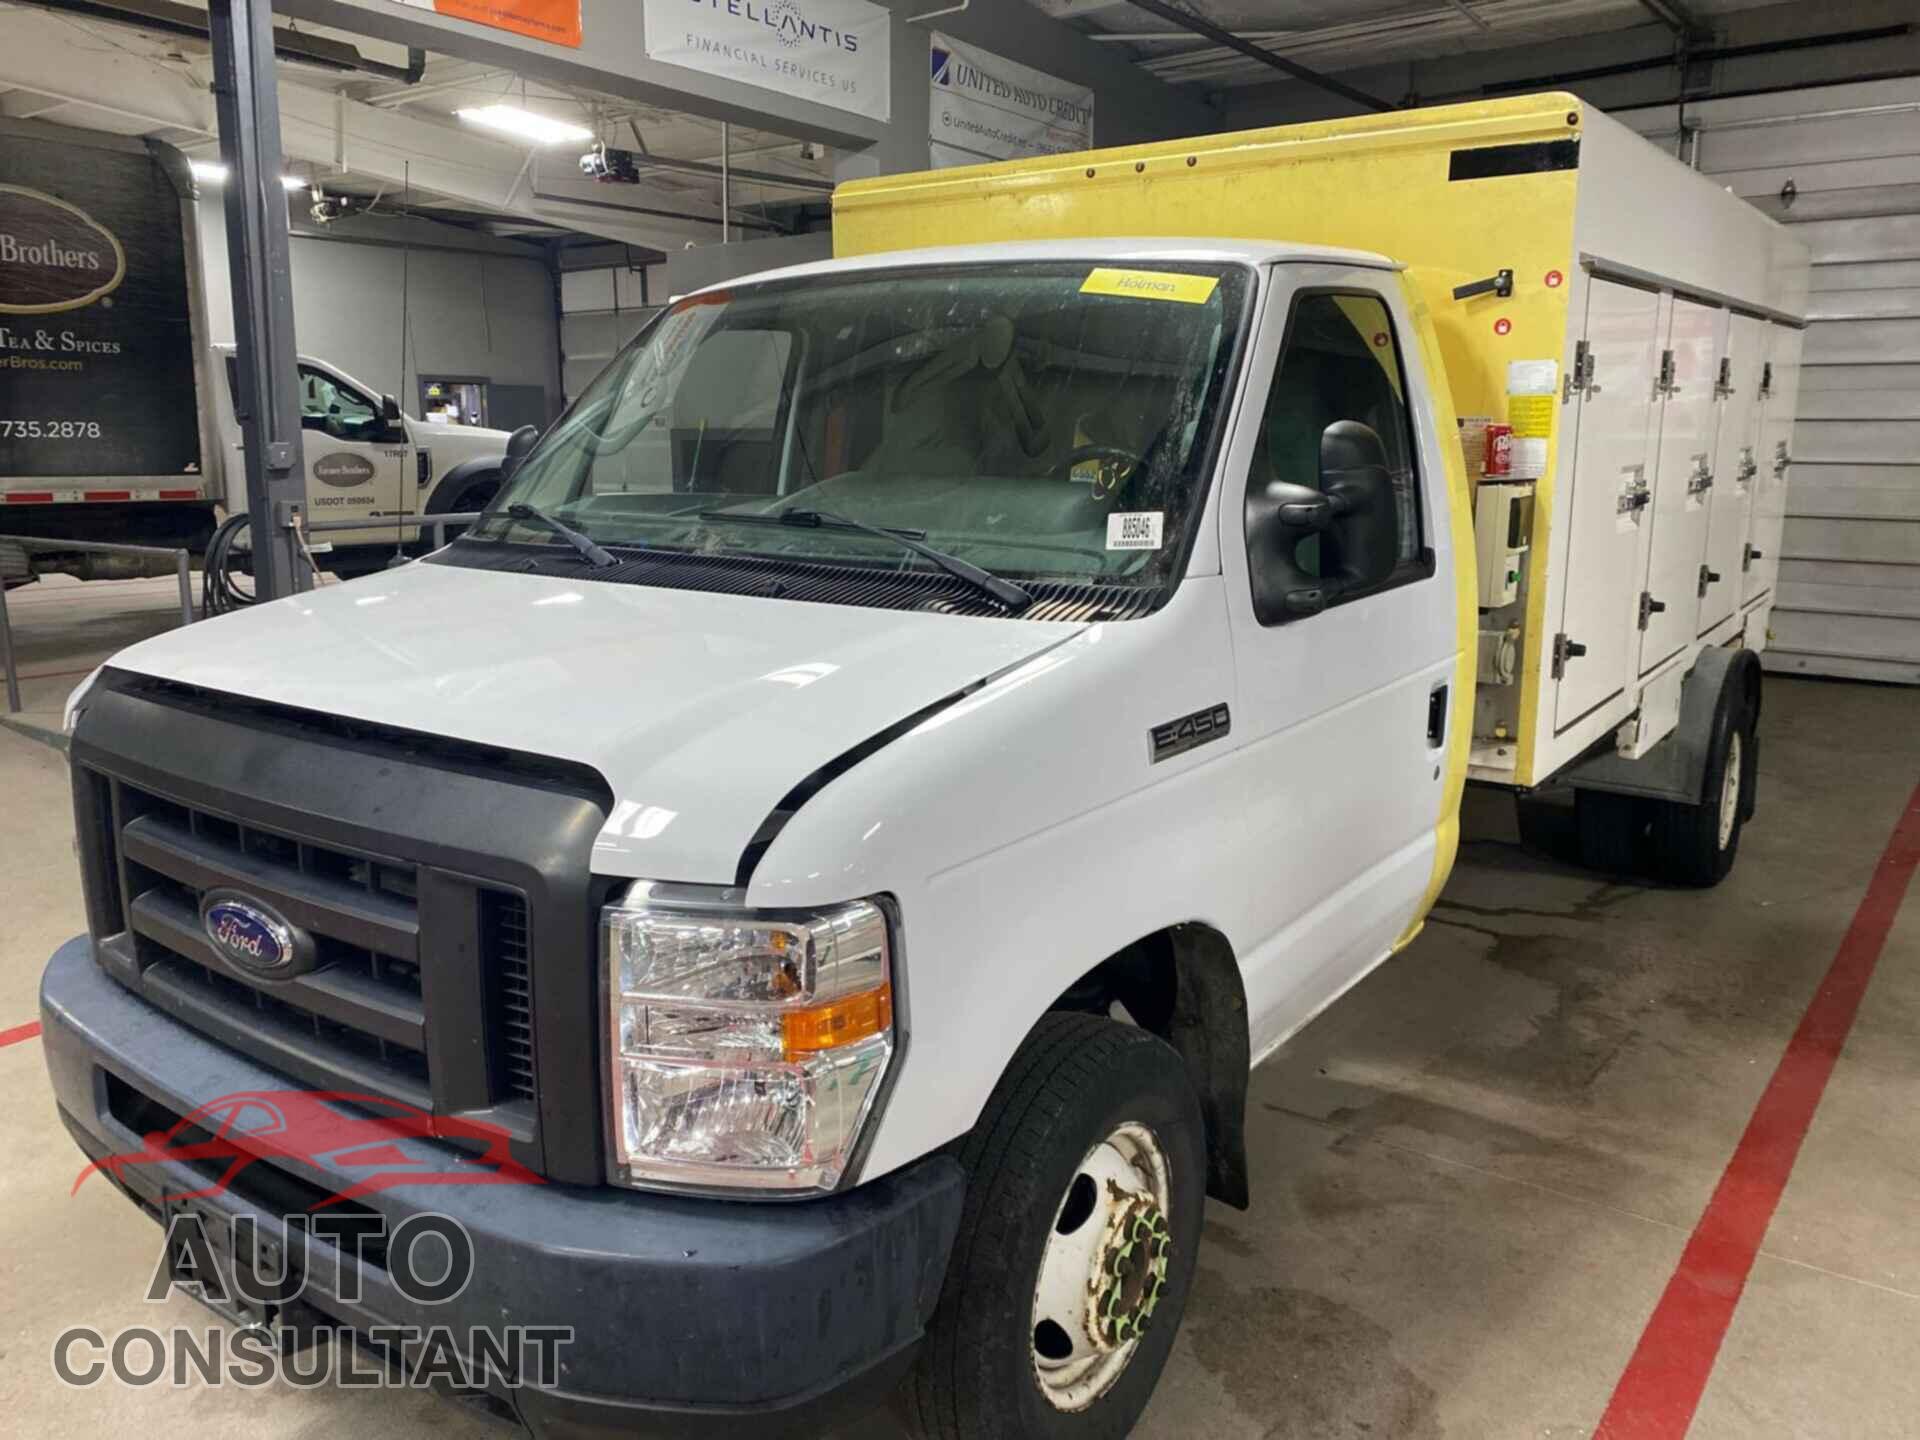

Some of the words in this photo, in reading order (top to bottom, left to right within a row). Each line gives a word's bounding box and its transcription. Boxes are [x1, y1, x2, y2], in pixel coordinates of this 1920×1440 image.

[691, 0, 858, 52] ELLANTIS
[686, 33, 768, 69] FINANCIAL
[774, 57, 836, 88] SERVICES
[842, 79, 857, 95] US
[955, 62, 1012, 99] UNITED
[1013, 84, 1048, 112] AUTO
[1049, 97, 1090, 126] CREDIT
[0, 234, 100, 270] Brothers
[34, 329, 56, 351] &
[314, 497, 344, 506] USDOT
[1153, 707, 1227, 750] E-450
[217, 913, 263, 957] Ford
